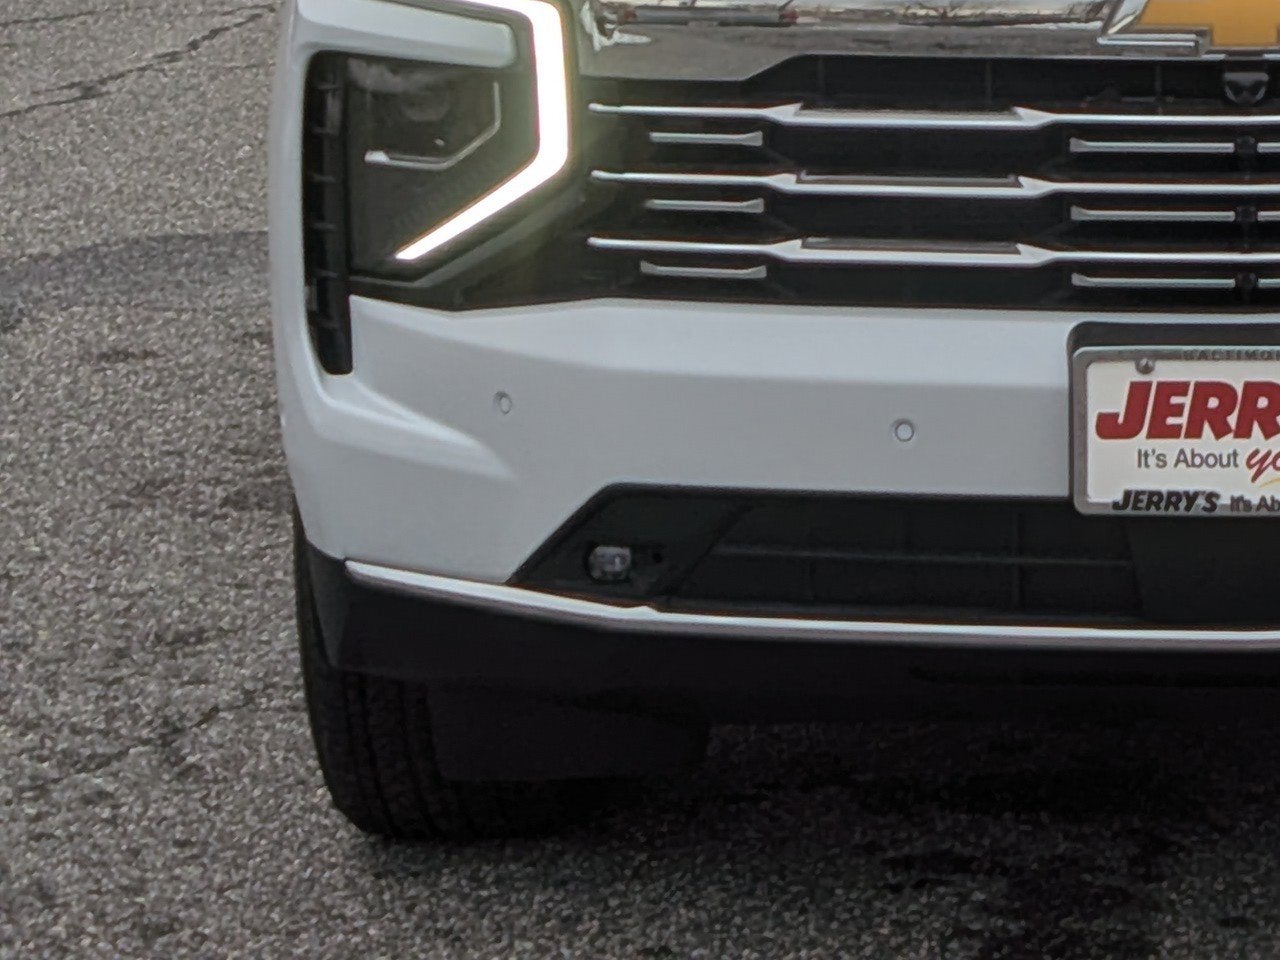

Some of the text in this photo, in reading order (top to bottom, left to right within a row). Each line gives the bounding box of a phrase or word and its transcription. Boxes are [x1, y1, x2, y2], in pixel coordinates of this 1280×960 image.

[1137, 449, 1168, 469] It's
[1173, 449, 1239, 469] About
[1112, 489, 1221, 513] JERRY'S
